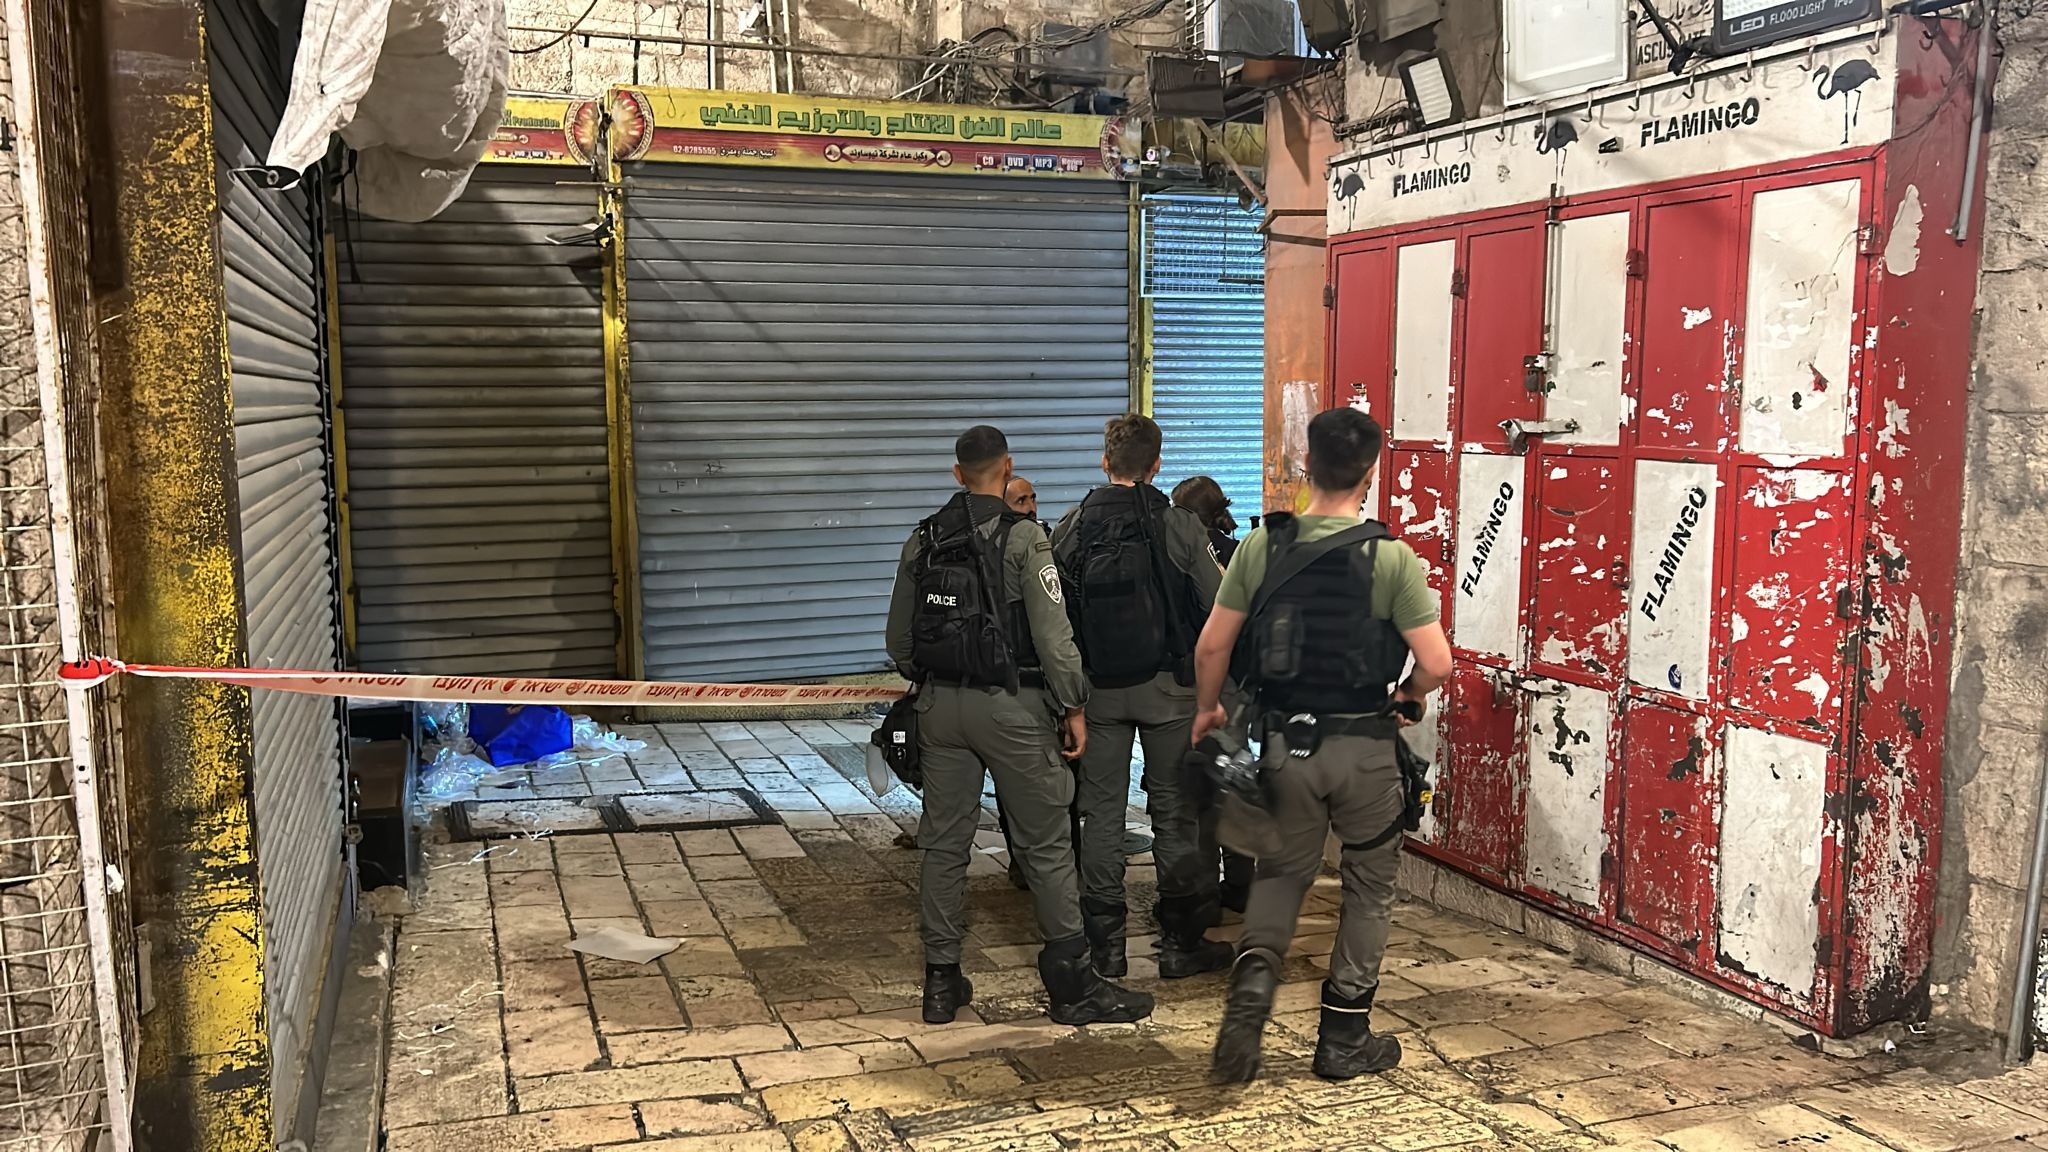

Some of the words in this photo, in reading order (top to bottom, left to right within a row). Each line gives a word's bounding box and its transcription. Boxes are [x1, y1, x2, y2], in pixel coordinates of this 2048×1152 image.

[1729, 15, 1766, 36] LED
[1769, 7, 1799, 25] FLOOD
[1799, 1, 1825, 17] LIGHT
[700, 103, 772, 127] الفني
[777, 108, 881, 136] والتوزيع
[959, 115, 1006, 140] الفن
[1010, 119, 1062, 141] عالم
[1640, 98, 1760, 148] FLAMINGO
[982, 156, 994, 166] CD
[1007, 157, 1024, 167] DVD
[1035, 158, 1053, 168] MP3
[1393, 162, 1471, 198] FLAMINGO
[1460, 481, 1514, 598] FLAMINGO
[1640, 486, 1708, 622] FLAMINGO
[926, 593, 957, 607] POLICE
[471, 678, 497, 694] אין
[520, 680, 565, 693] ישראל
[583, 683, 633, 695] משטרת
[646, 685, 675, 697] מעבר
[672, 685, 693, 699] אין
[707, 685, 740, 697] ישראל
[752, 686, 789, 697] משטרת
